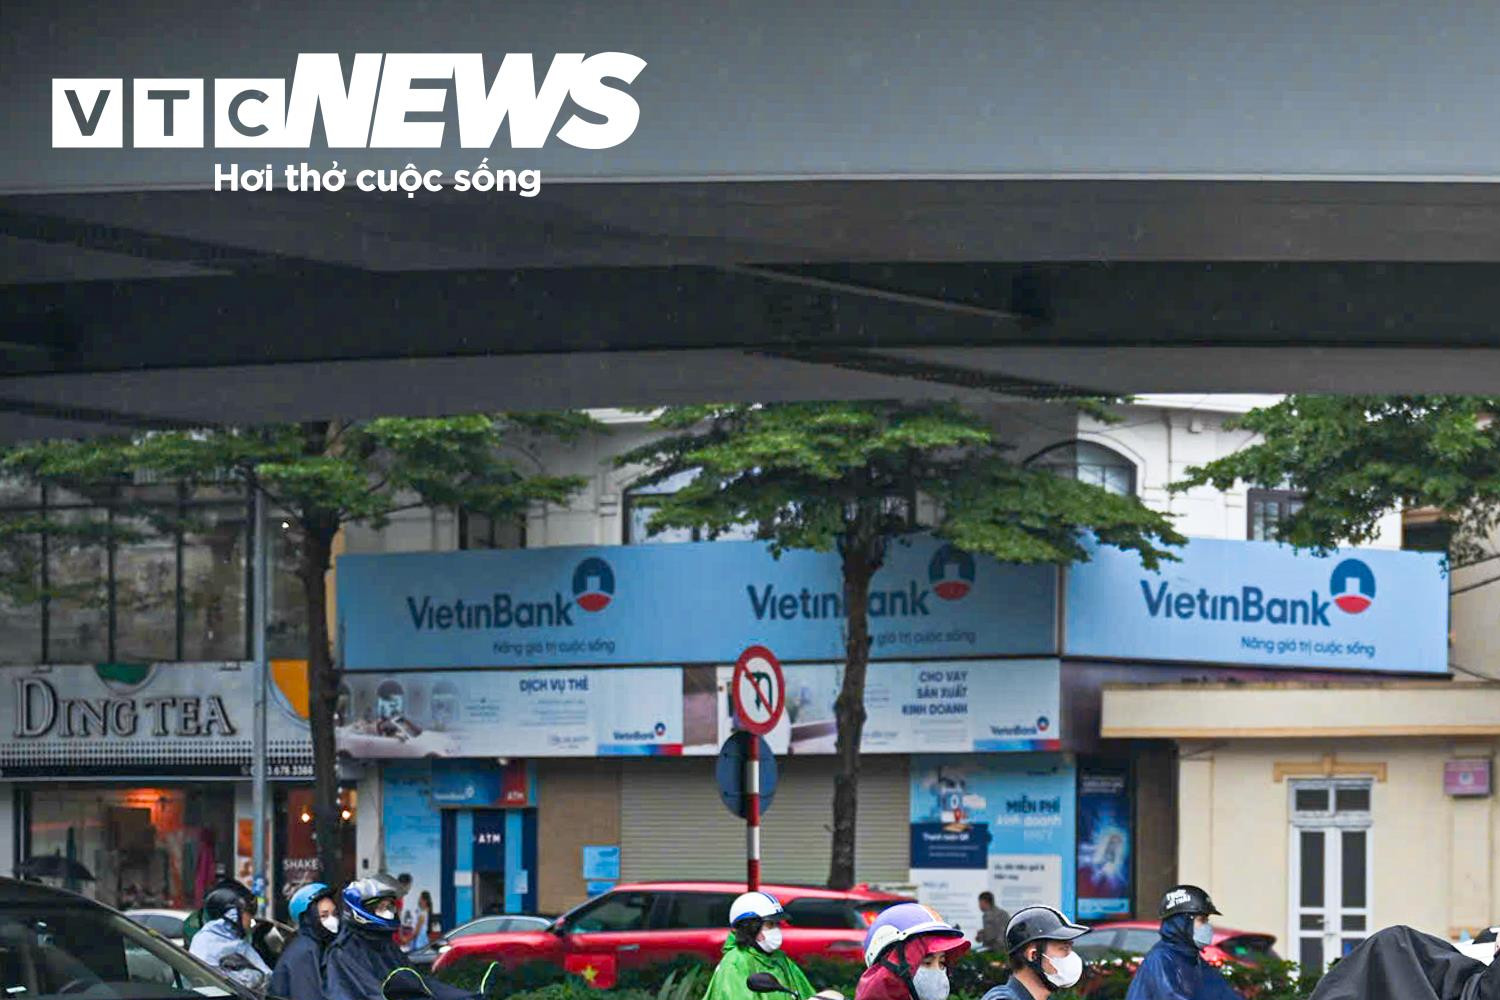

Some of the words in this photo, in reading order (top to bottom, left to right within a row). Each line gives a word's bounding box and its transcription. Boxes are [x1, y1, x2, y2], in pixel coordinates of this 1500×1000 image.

[407, 592, 573, 631] VietinBank
[747, 579, 930, 621] Vietinank
[1140, 578, 1331, 627] VietinBank
[519, 678, 548, 695] DỊCH
[919, 671, 943, 683] CHO
[948, 670, 968, 682] VAY
[13, 677, 139, 738] DING
[145, 696, 236, 736] TEA
[478, 833, 501, 844] ATM
